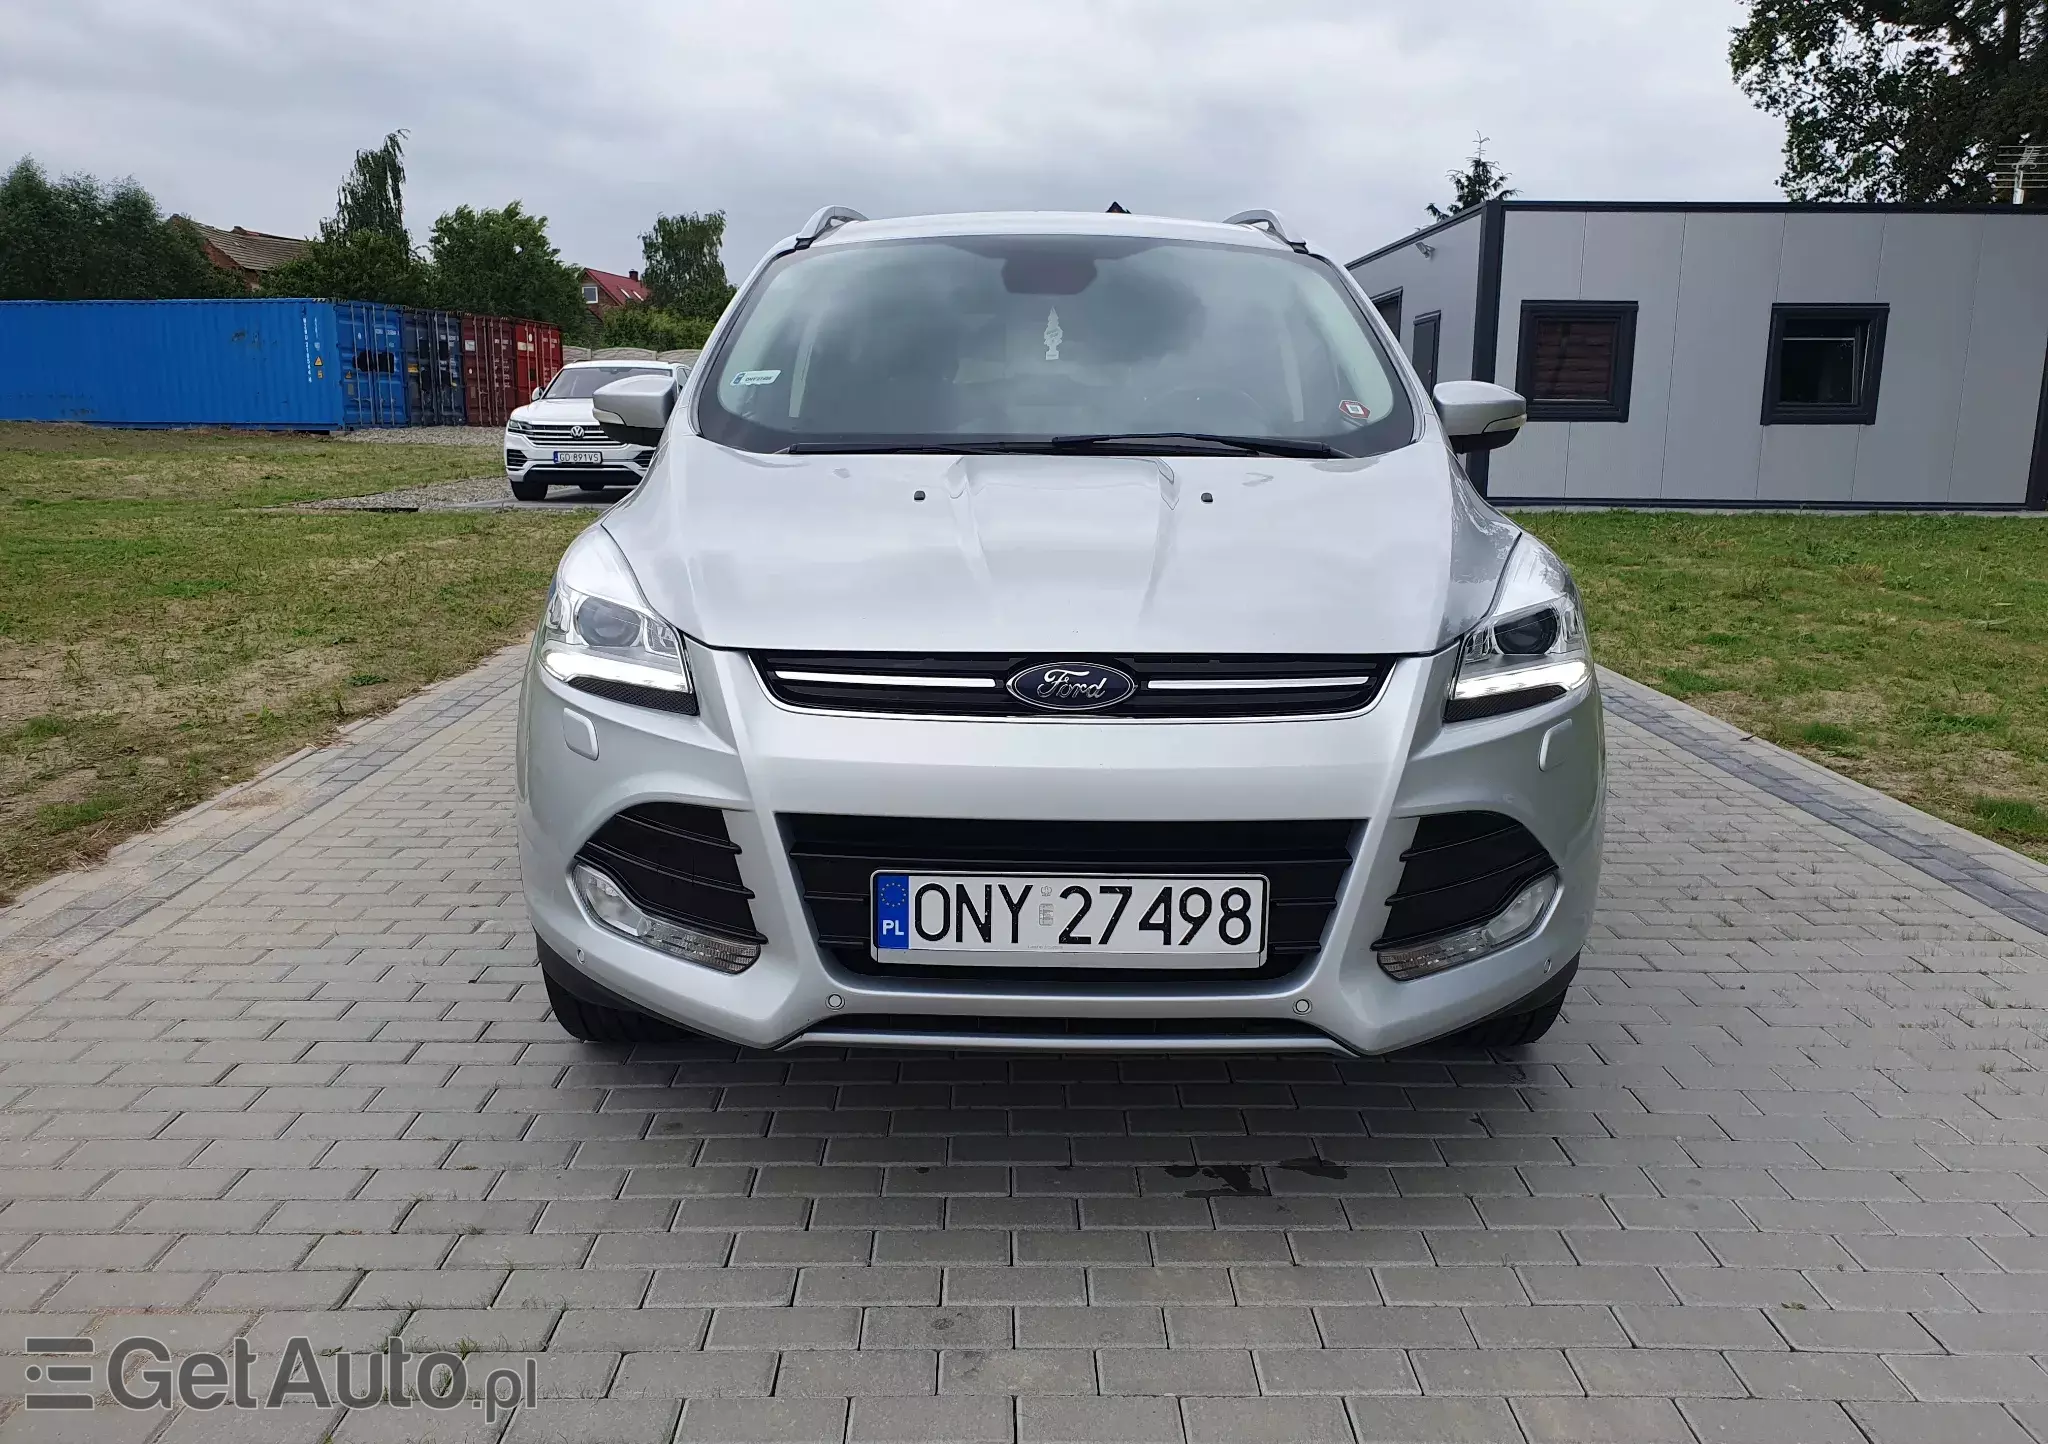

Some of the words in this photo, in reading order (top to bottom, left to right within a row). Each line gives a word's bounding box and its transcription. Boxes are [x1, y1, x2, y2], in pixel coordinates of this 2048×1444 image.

[559, 453, 571, 462] GD
[573, 453, 599, 462] 891VS
[1036, 668, 1108, 699] Ford
[882, 919, 905, 936] PL
[914, 882, 1034, 944] ONY
[1058, 885, 1252, 946] 27498
